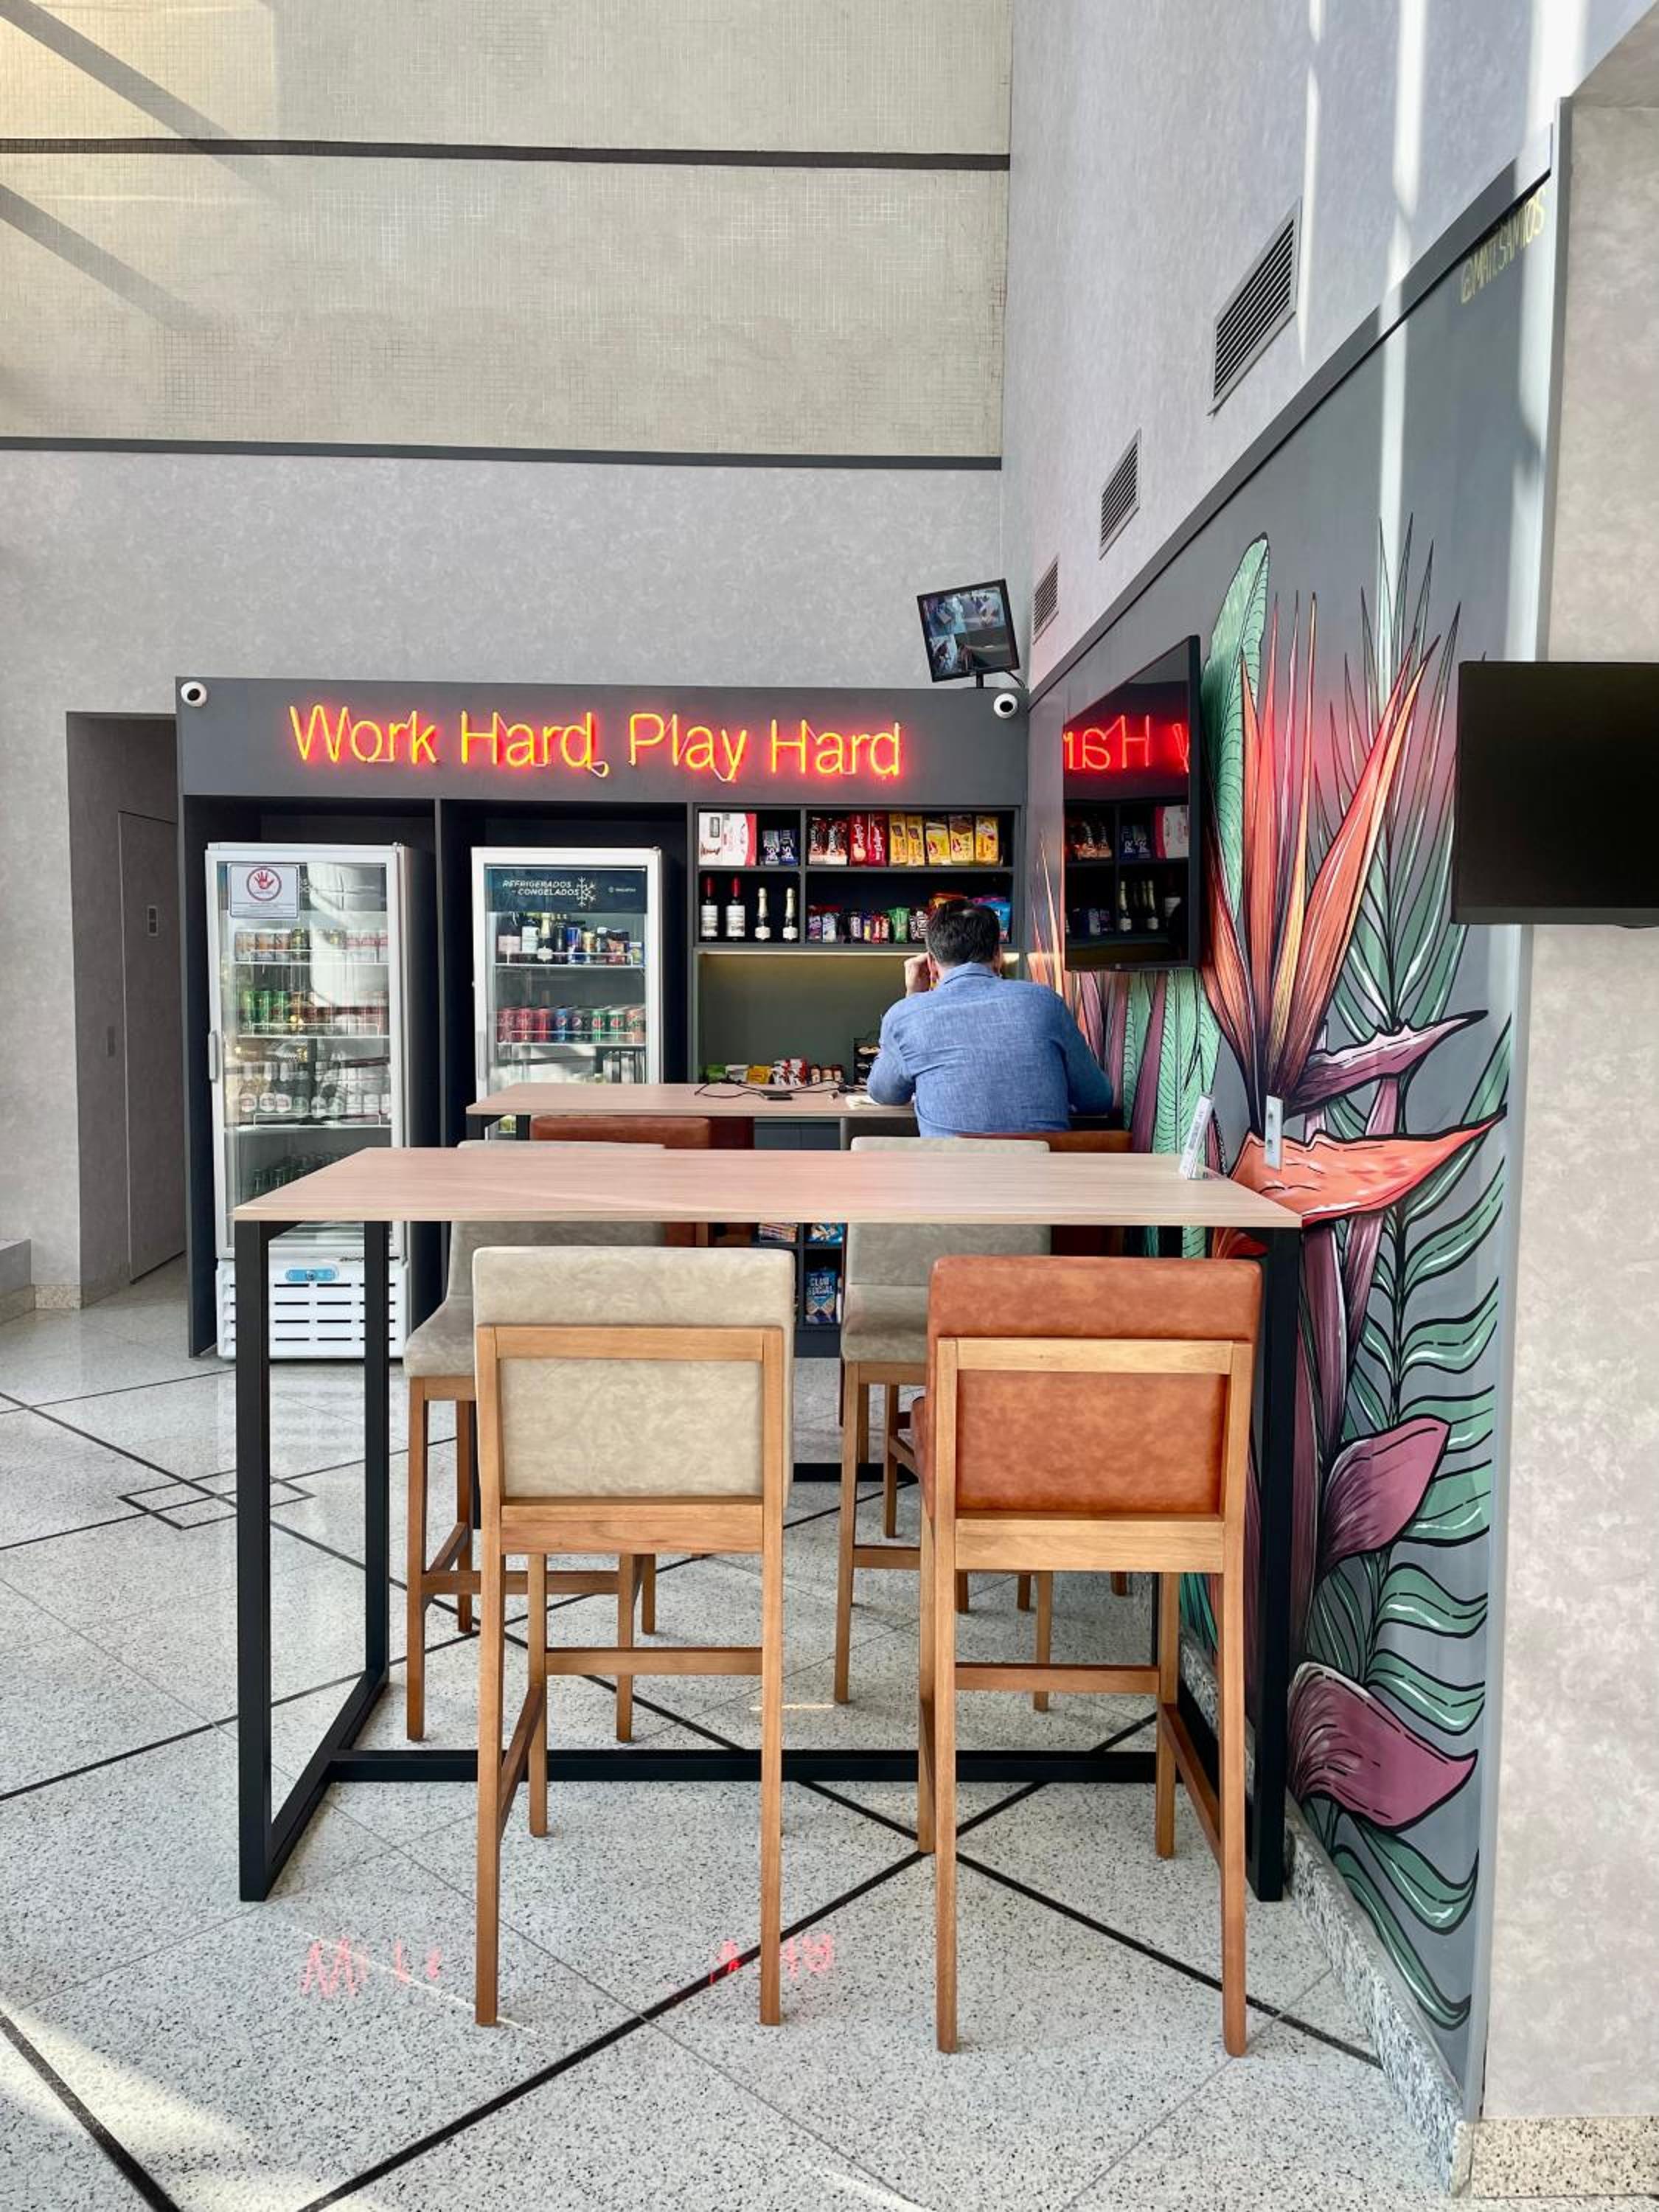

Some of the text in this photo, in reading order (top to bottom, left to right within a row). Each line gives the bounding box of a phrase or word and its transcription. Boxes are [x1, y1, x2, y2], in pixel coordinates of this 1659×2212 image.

[289, 704, 437, 765] Work
[628, 712, 746, 783] Play
[771, 718, 901, 777] Hard
[502, 880, 571, 888] REFRIGERADOS
